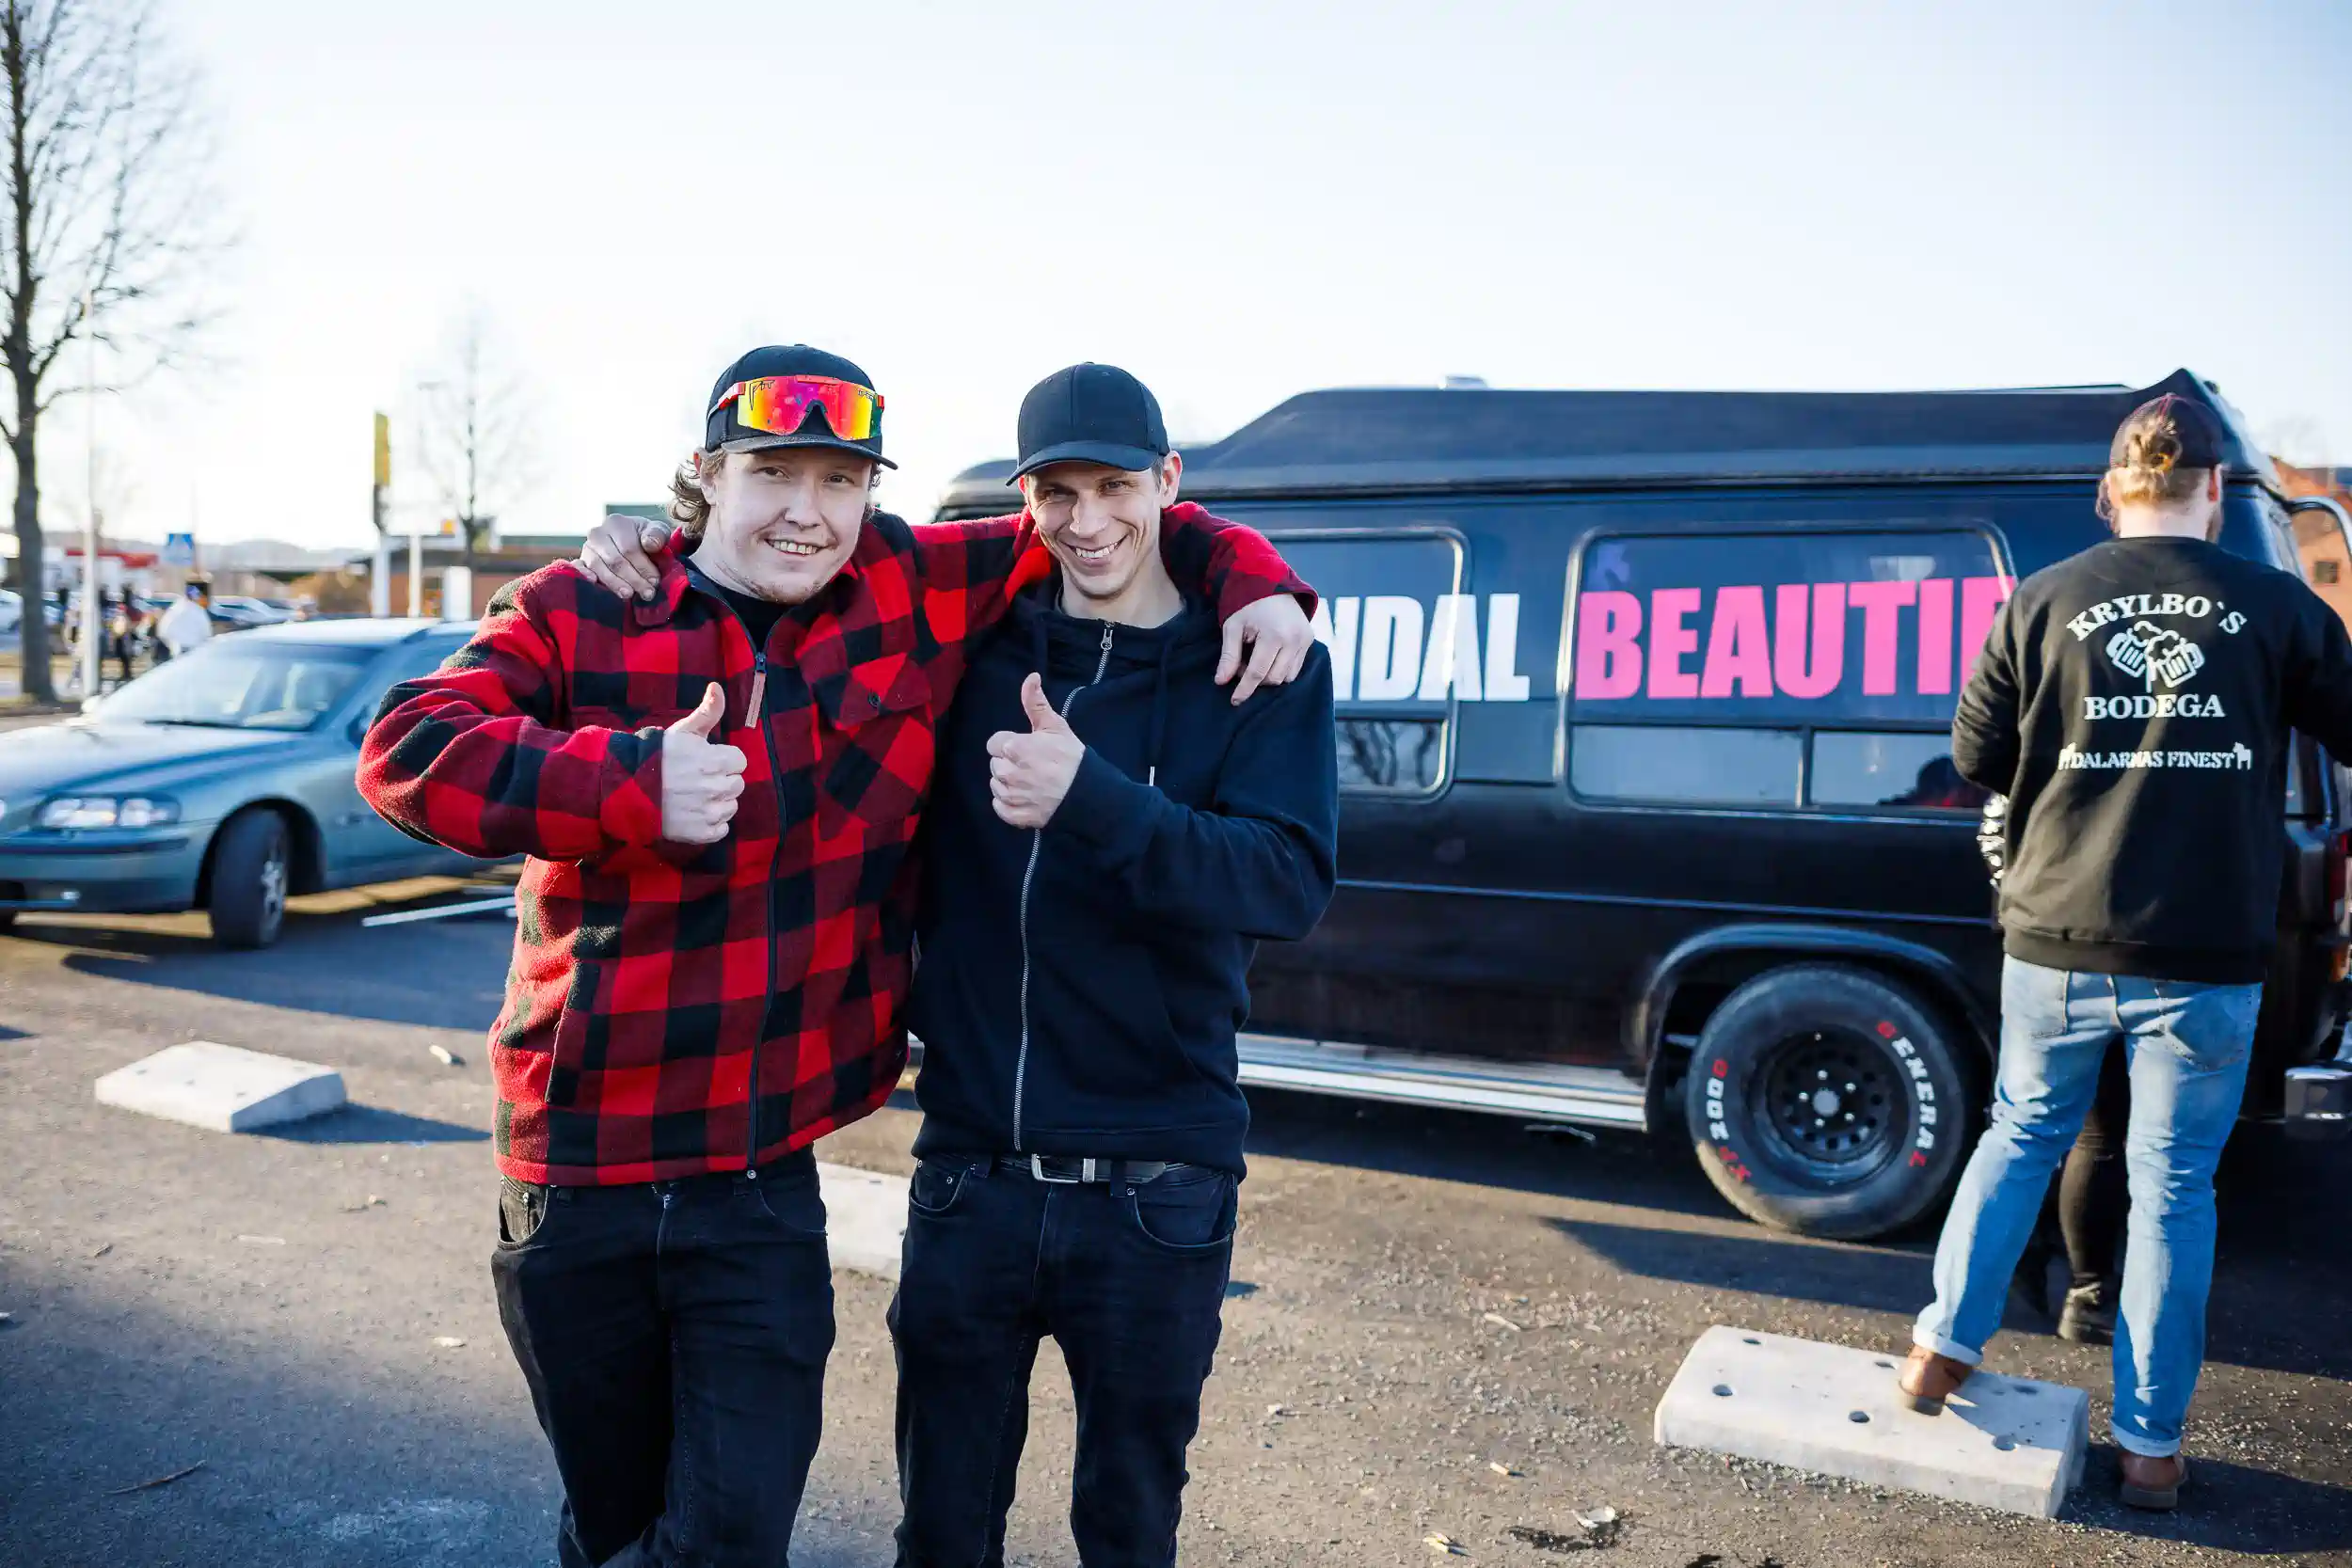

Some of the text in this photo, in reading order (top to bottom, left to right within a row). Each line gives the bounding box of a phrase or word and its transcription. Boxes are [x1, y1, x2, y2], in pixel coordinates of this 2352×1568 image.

[2083, 694, 2226, 721] BODEGA
[2070, 751, 2235, 770] DALARNAS FINEST
